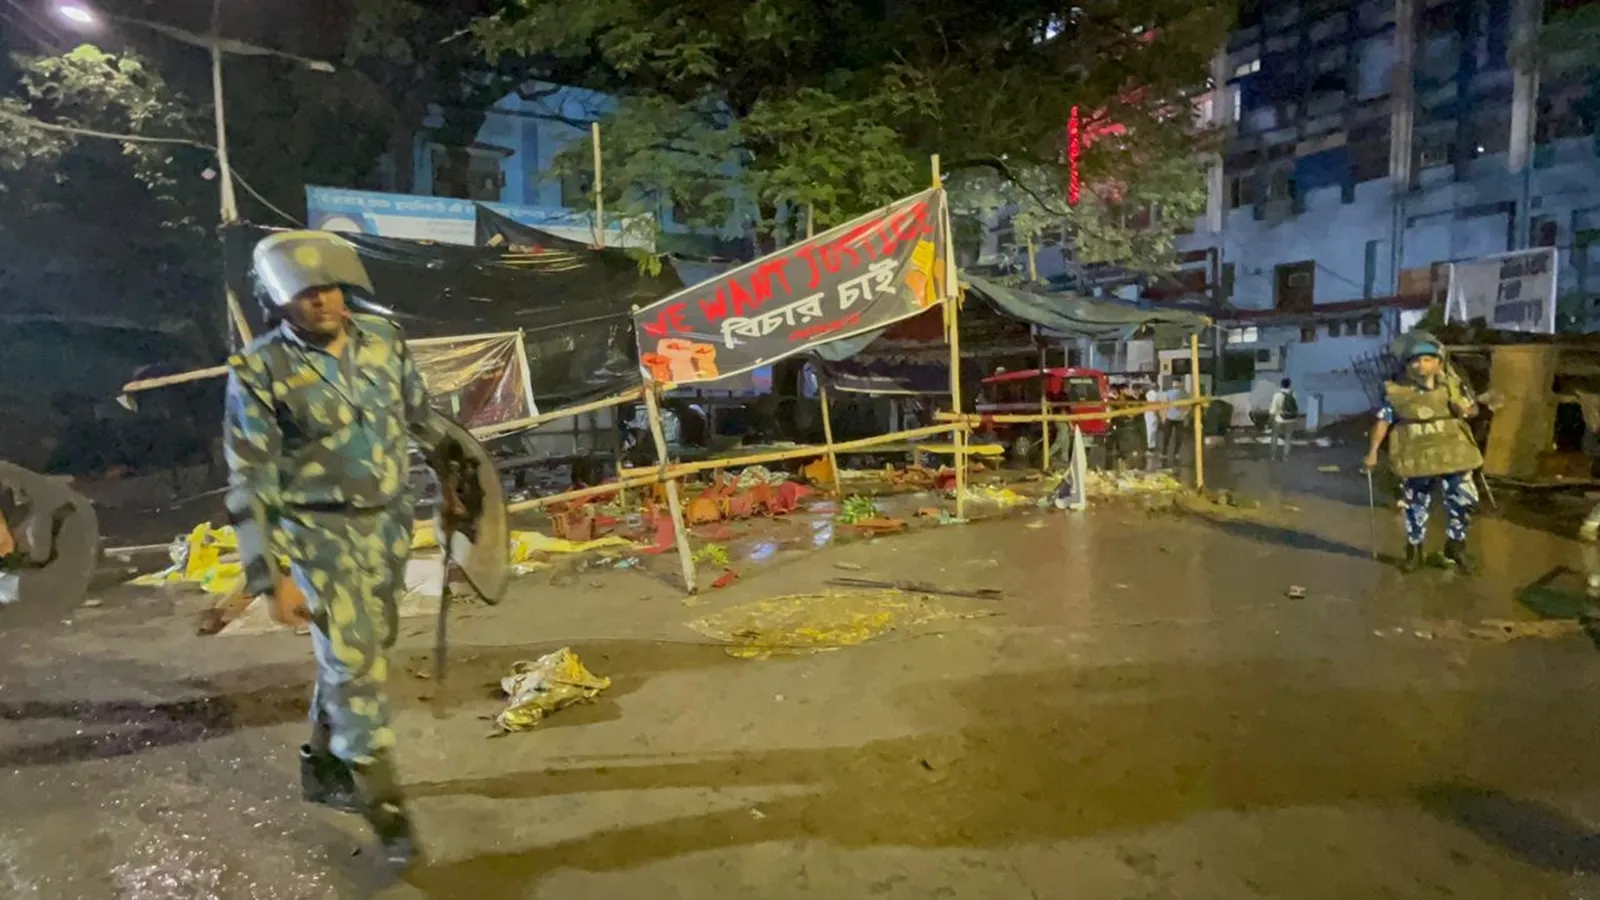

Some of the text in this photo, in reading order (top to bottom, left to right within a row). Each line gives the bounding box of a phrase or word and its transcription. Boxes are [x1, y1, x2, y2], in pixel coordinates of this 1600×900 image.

[698, 257, 792, 326] WANT
[794, 201, 932, 289] JUSTICE
[720, 292, 825, 350] বিচার
[837, 258, 899, 310] চাই
